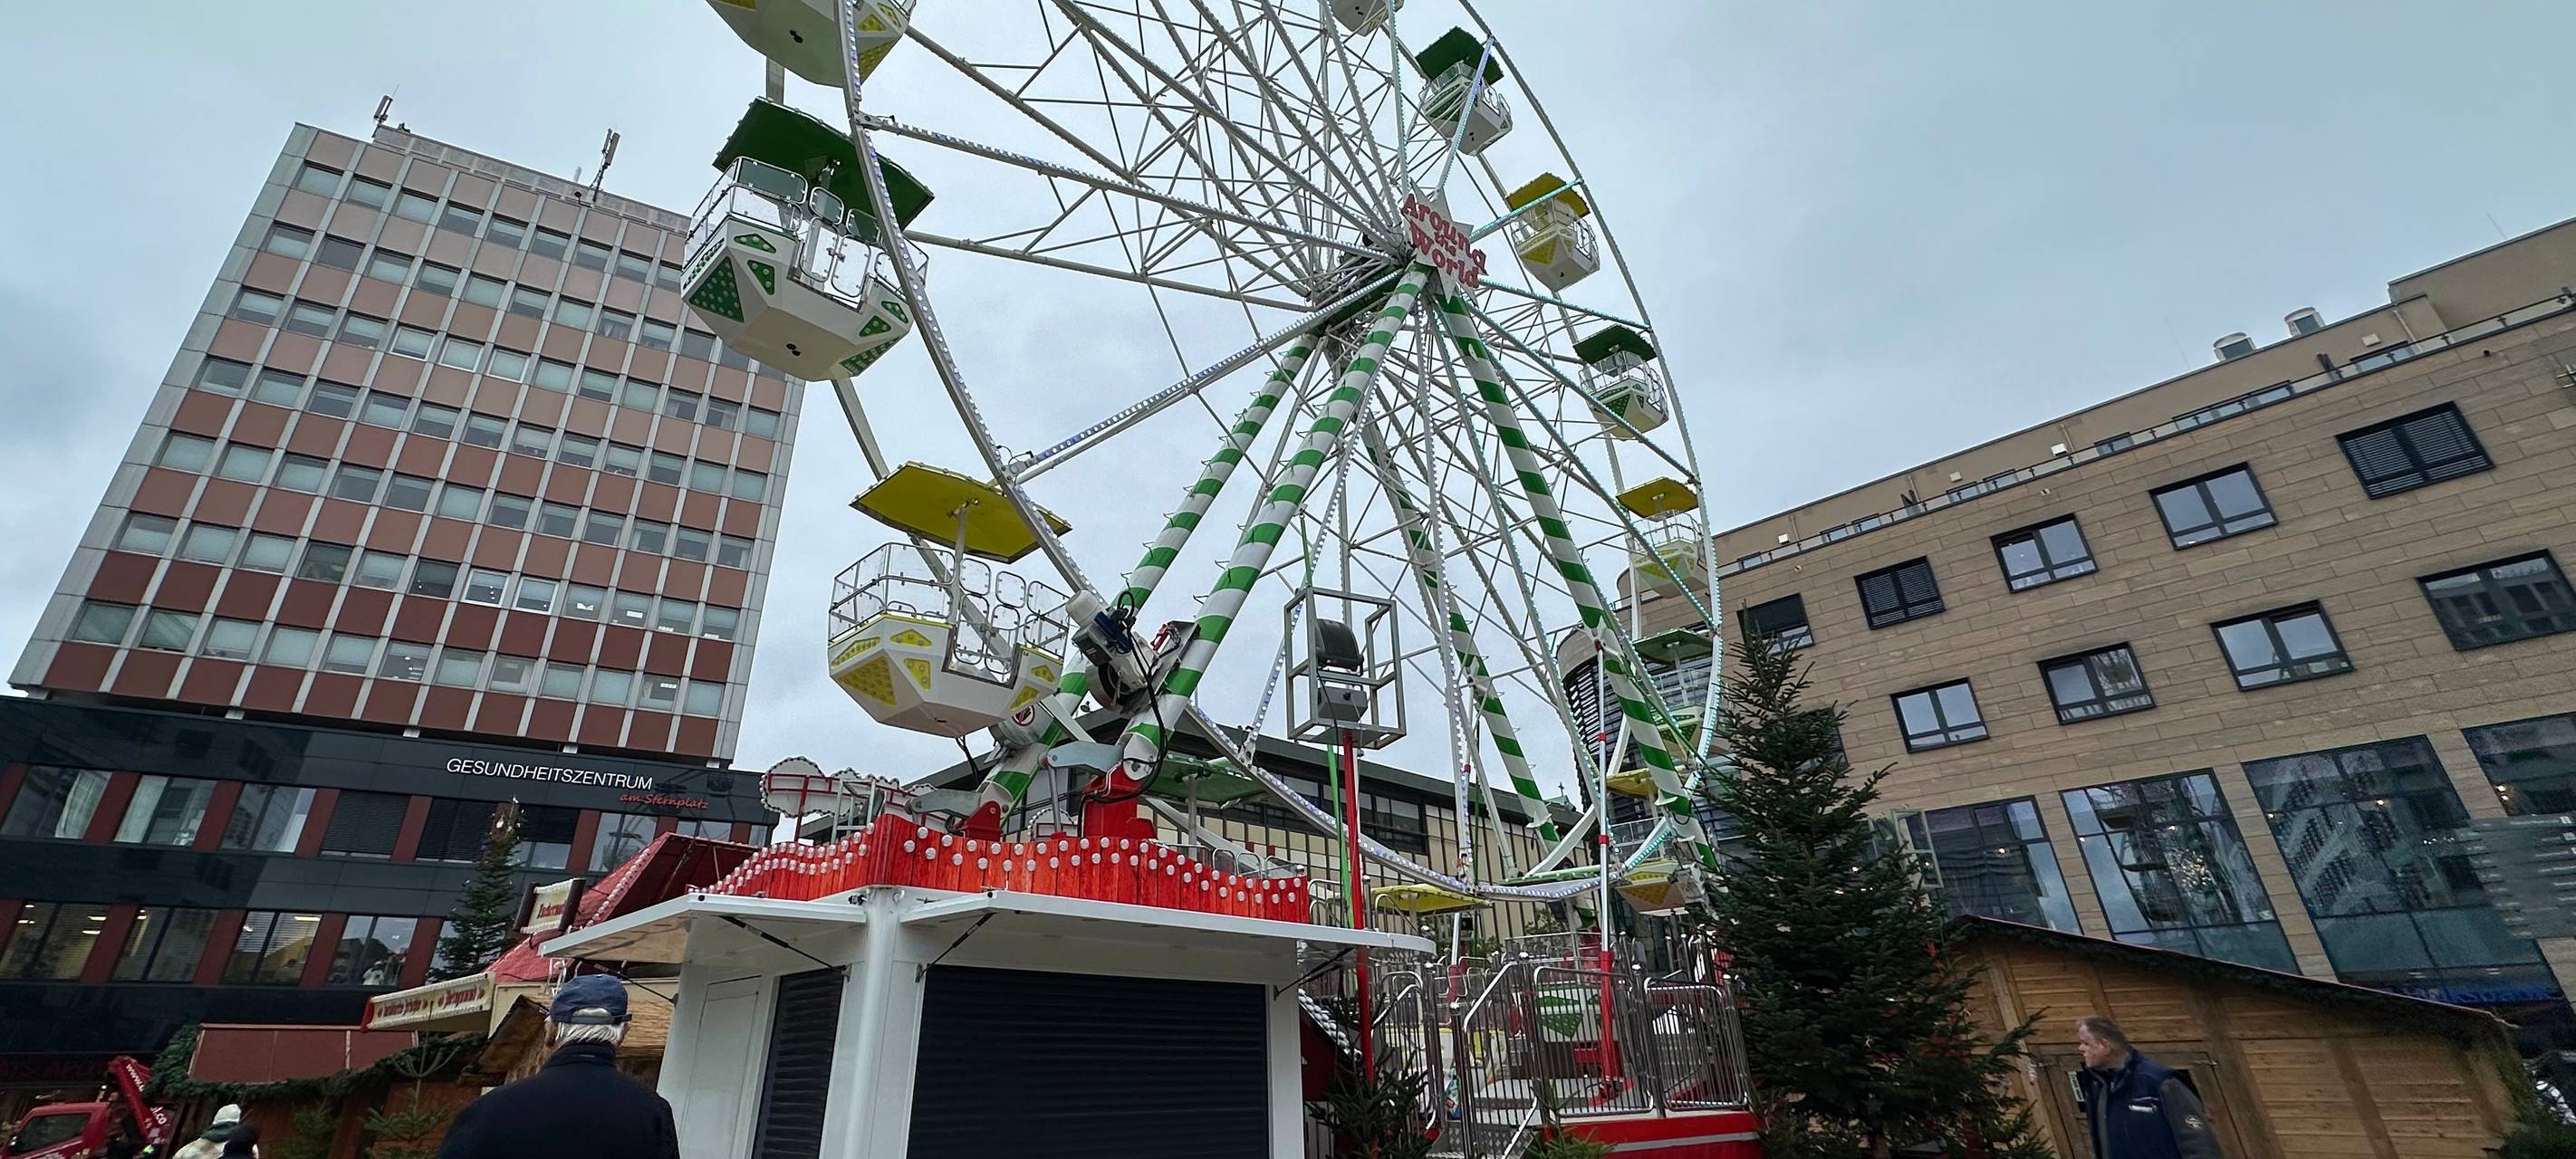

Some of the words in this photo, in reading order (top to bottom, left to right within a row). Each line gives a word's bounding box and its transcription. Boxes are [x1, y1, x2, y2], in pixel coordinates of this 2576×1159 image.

[1409, 220, 1480, 289] World
[446, 758, 653, 790] GESUNDHEITSZENTRUM
[620, 794, 642, 803] am
[643, 793, 710, 809] Sternplatz
